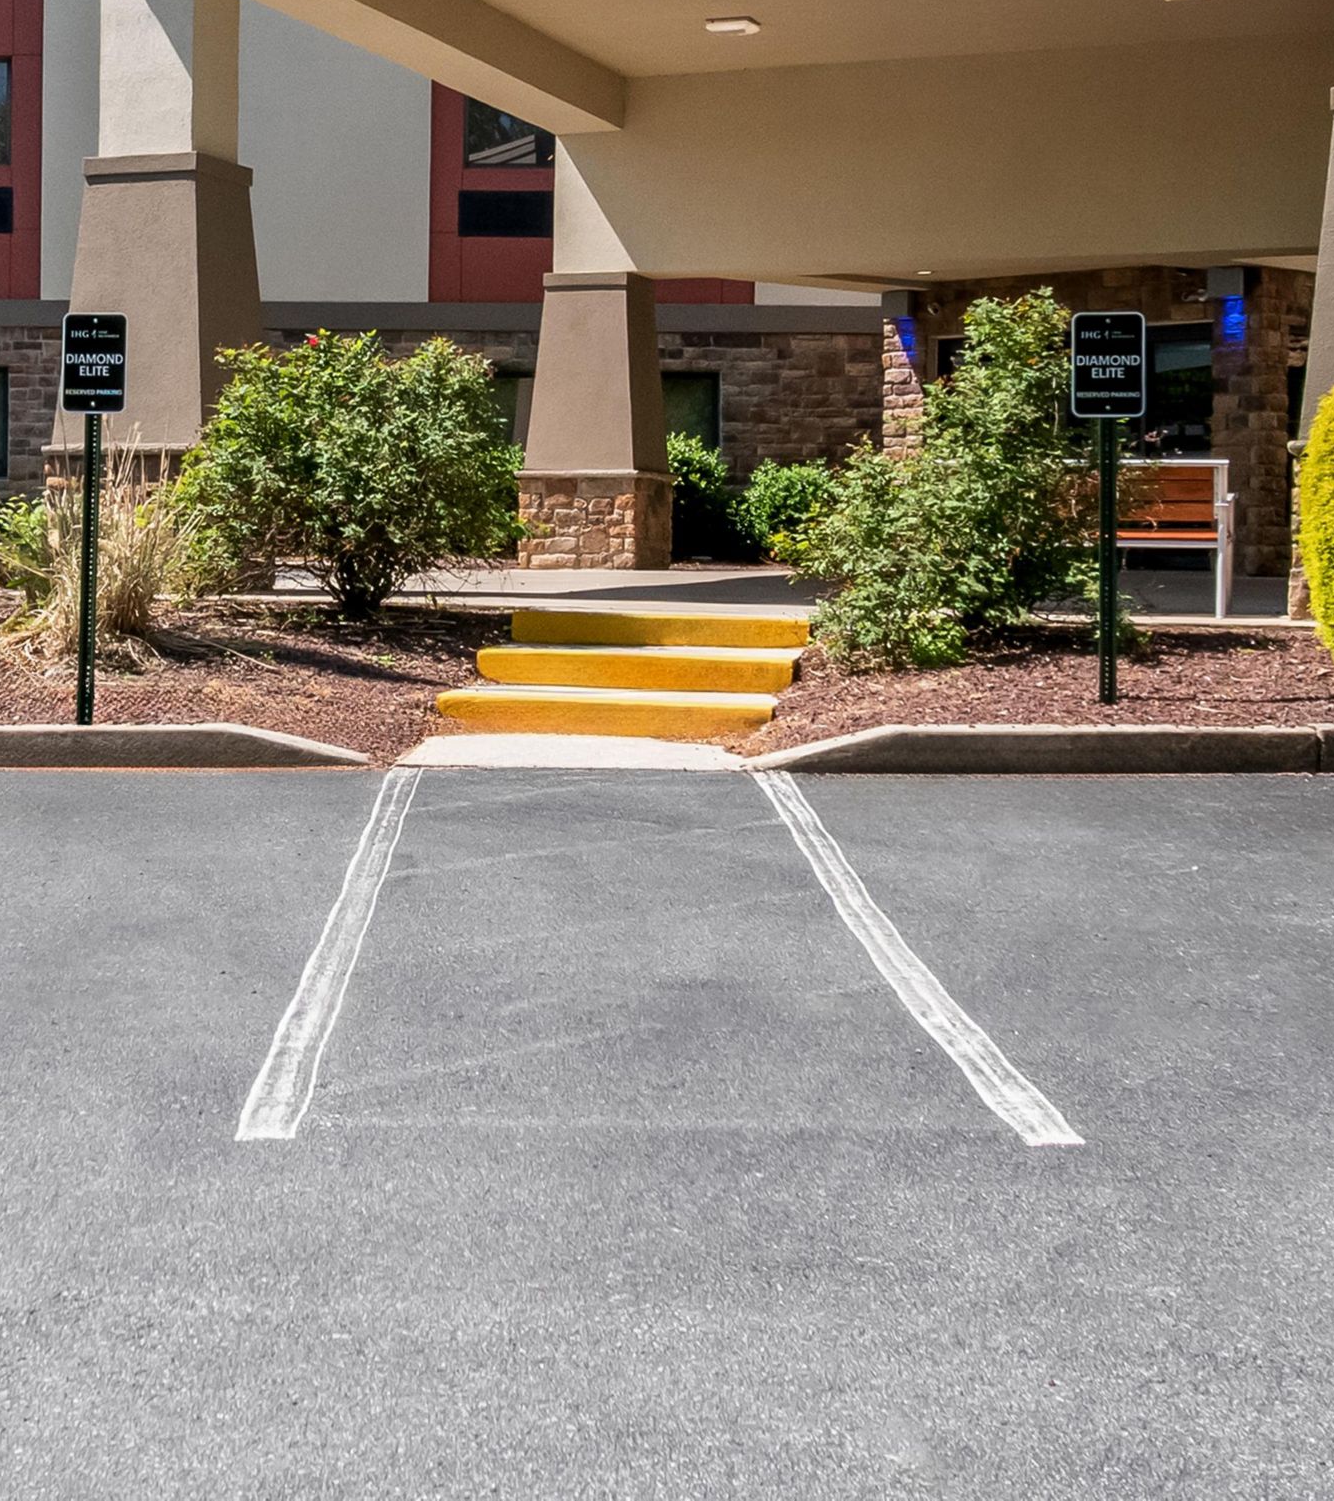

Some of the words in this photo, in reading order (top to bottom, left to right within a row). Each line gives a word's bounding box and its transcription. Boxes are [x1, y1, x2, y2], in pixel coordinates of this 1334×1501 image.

[66, 353, 123, 364] DIAMOND
[1076, 355, 1141, 366] DIAMOND
[79, 365, 110, 376] ELITE
[1091, 367, 1125, 378] ELITE
